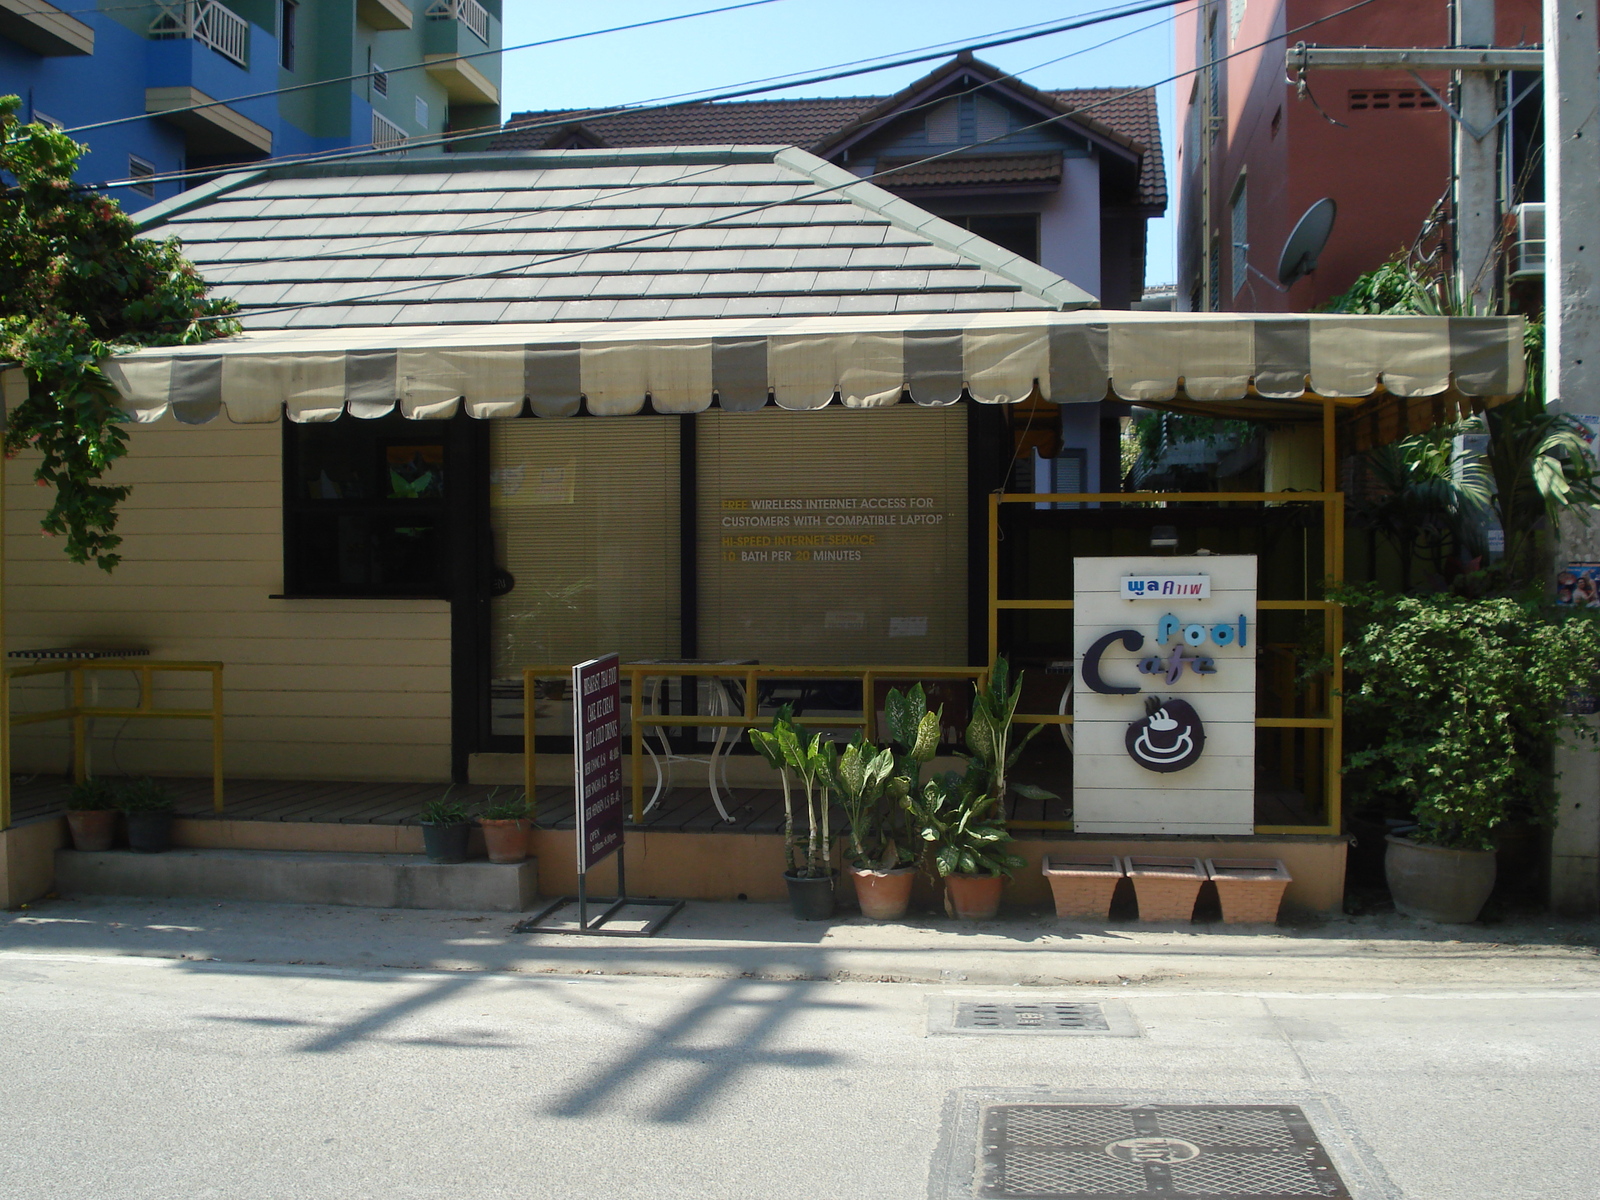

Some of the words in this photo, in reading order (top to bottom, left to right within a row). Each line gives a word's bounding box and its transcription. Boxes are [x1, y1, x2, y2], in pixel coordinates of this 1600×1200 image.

[721, 499, 748, 510] FREE
[751, 499, 803, 510] WIRELESS
[806, 498, 857, 509] INTERNET
[860, 498, 906, 509] ACCESS
[910, 497, 934, 509] FOR
[721, 515, 790, 527] CUSTOMERS
[793, 515, 821, 526] WITH
[825, 515, 896, 526] COMPATIBLE
[900, 514, 943, 525] LAPTOP
[721, 536, 771, 547] HI-SPEED
[774, 535, 826, 546] INTERNET
[828, 534, 876, 546] SERVICE
[721, 551, 736, 562] 10
[741, 551, 768, 562] BATH
[771, 551, 792, 562] PER
[795, 551, 811, 562] 20
[813, 550, 862, 561] MINUTES
[1157, 613, 1247, 648] Pool
[1081, 629, 1218, 695] Cafe
